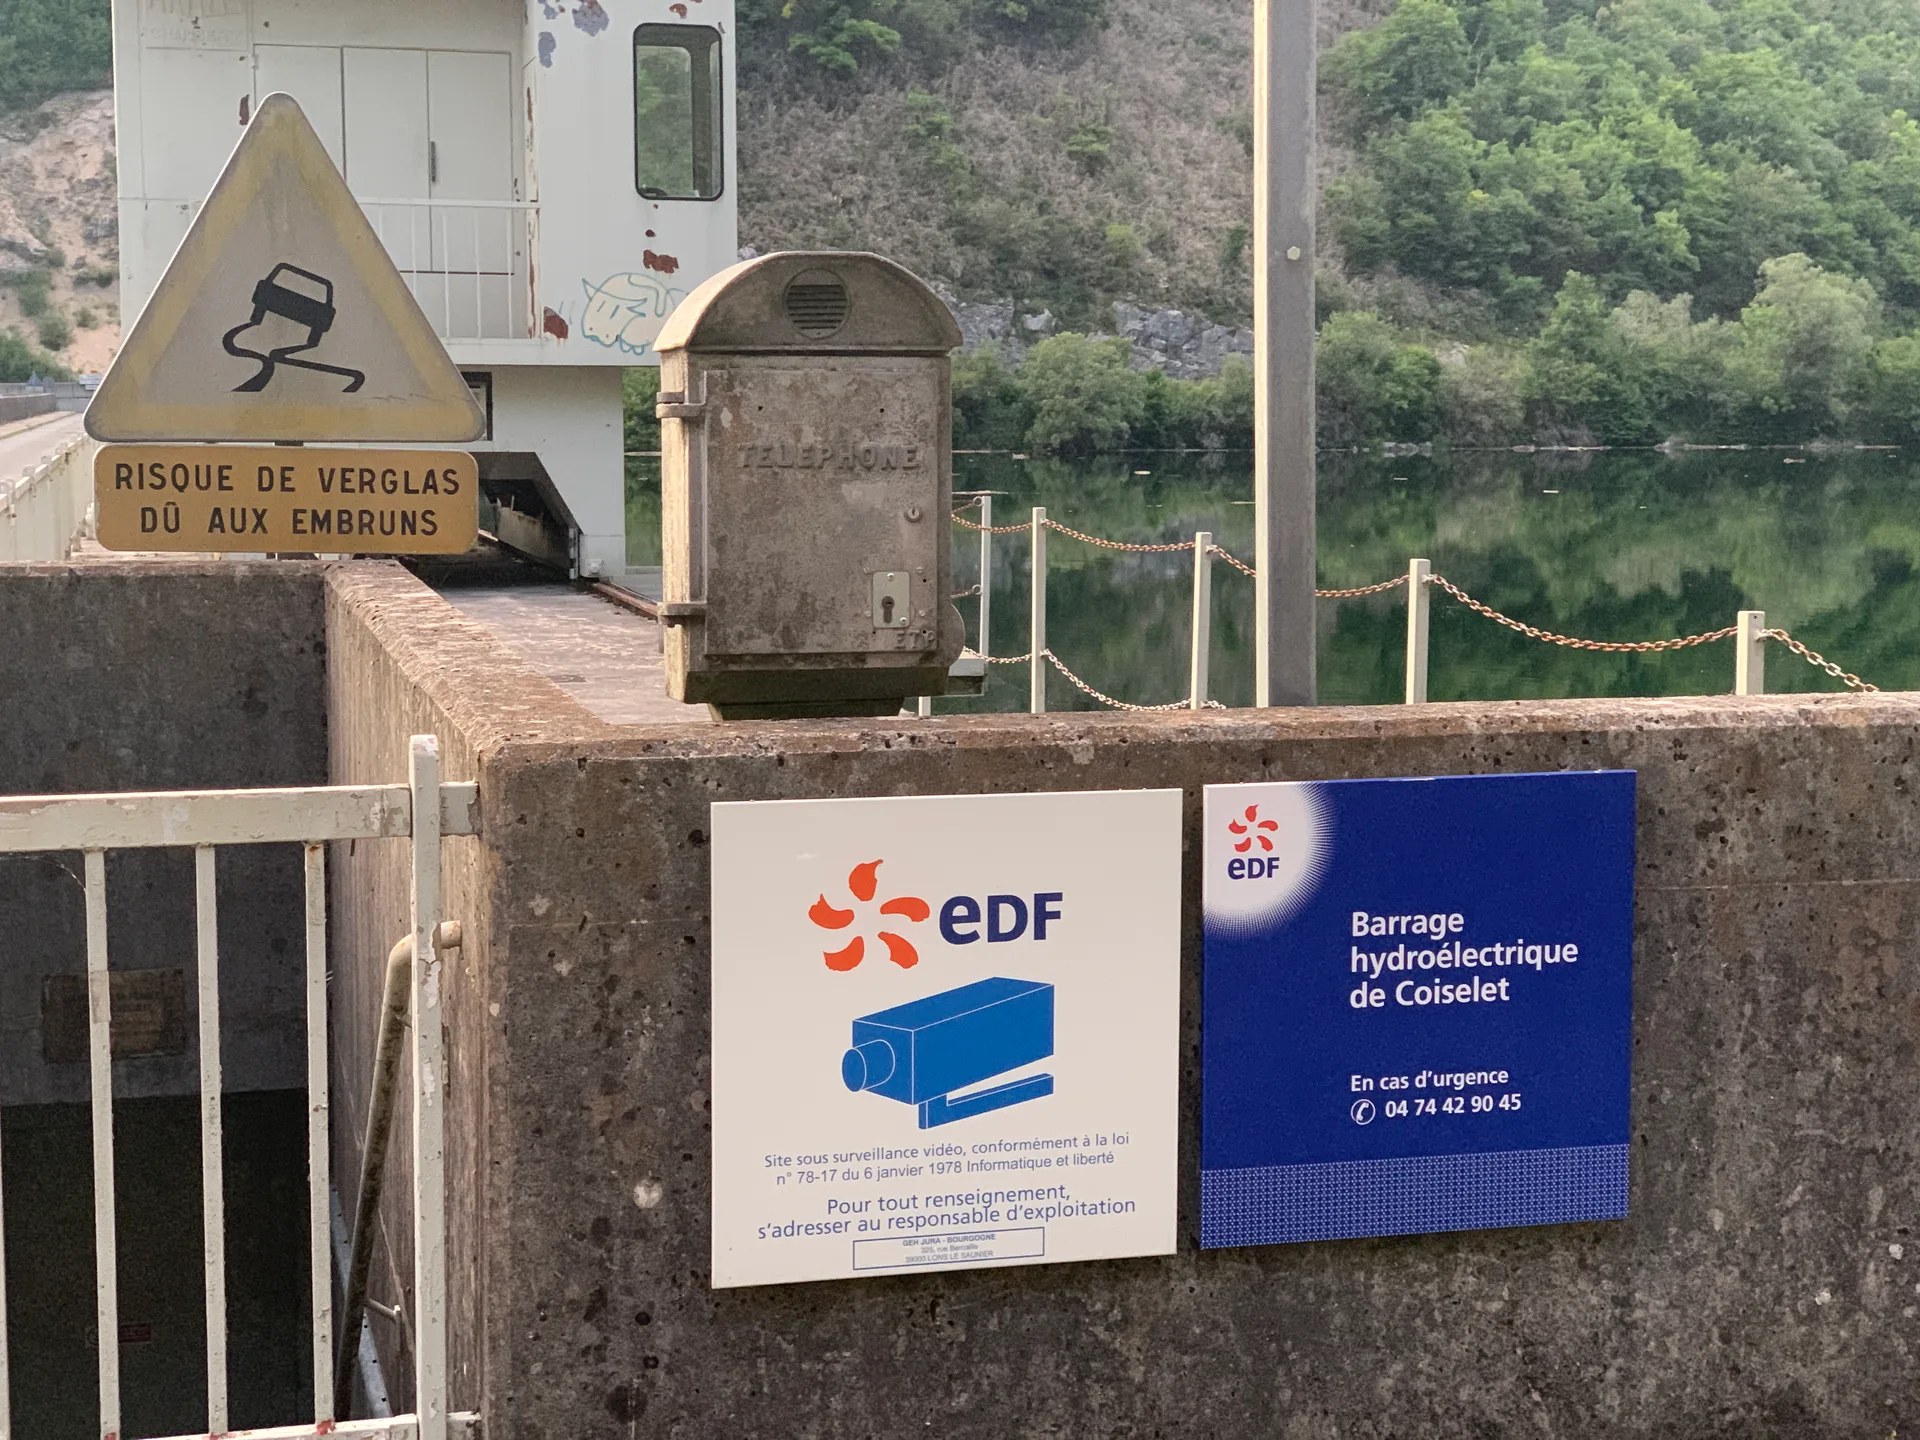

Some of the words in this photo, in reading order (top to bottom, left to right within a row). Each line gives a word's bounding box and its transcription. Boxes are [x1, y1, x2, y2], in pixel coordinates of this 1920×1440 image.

[738, 444, 919, 471] TELEPHONE
[116, 463, 233, 492] RISQUE
[258, 466, 295, 492] DE
[318, 468, 459, 495] VERGLAS
[141, 502, 179, 533] DÛ
[208, 507, 268, 534] AUX
[293, 509, 437, 535] EMBRUNS
[1353, 912, 1464, 940] Barrage
[1352, 939, 1578, 979] hydroélectrique
[1350, 981, 1385, 1008] de
[1396, 976, 1509, 1005] Coiselet
[1351, 1075, 1373, 1091] En
[1380, 1076, 1409, 1090] cas
[1415, 1070, 1508, 1090] d'urgence
[1386, 1100, 1408, 1117] 04
[1414, 1099, 1437, 1115] 74
[1442, 1097, 1464, 1113] 42
[1471, 1095, 1493, 1112] 90
[1499, 1094, 1521, 1110] 45
[765, 1155, 792, 1167] Site
[797, 1154, 828, 1165] sous
[833, 1147, 918, 1163] surveillance
[923, 1143, 966, 1156] vidéo,
[972, 1137, 1078, 1154] conformément
[1083, 1135, 1090, 1146] à
[1096, 1134, 1107, 1145] la
[1113, 1133, 1128, 1144] loi
[777, 1172, 791, 1185] n°
[798, 1169, 837, 1183] 78-17
[842, 1169, 859, 1180] du
[864, 1167, 872, 1179] 6
[877, 1167, 923, 1181] janvier
[929, 1161, 962, 1174] 1978
[968, 1157, 1051, 1172] Informatique
[1056, 1155, 1068, 1166] et
[1074, 1151, 1114, 1165] liberté
[828, 1199, 871, 1214] Pour
[878, 1195, 918, 1211] tout
[925, 1185, 1070, 1208] renseignement,
[759, 1220, 851, 1239] s'adresser
[858, 1219, 880, 1231] au
[888, 1207, 1000, 1231] responsable
[1006, 1198, 1135, 1222] d'exploitation
[921, 1238, 941, 1246] JURA
[947, 1234, 996, 1244] BOURGOGNE
[905, 1255, 926, 1263] 39000
[950, 1252, 959, 1260] LE
[961, 1250, 993, 1258] SAUNIER
